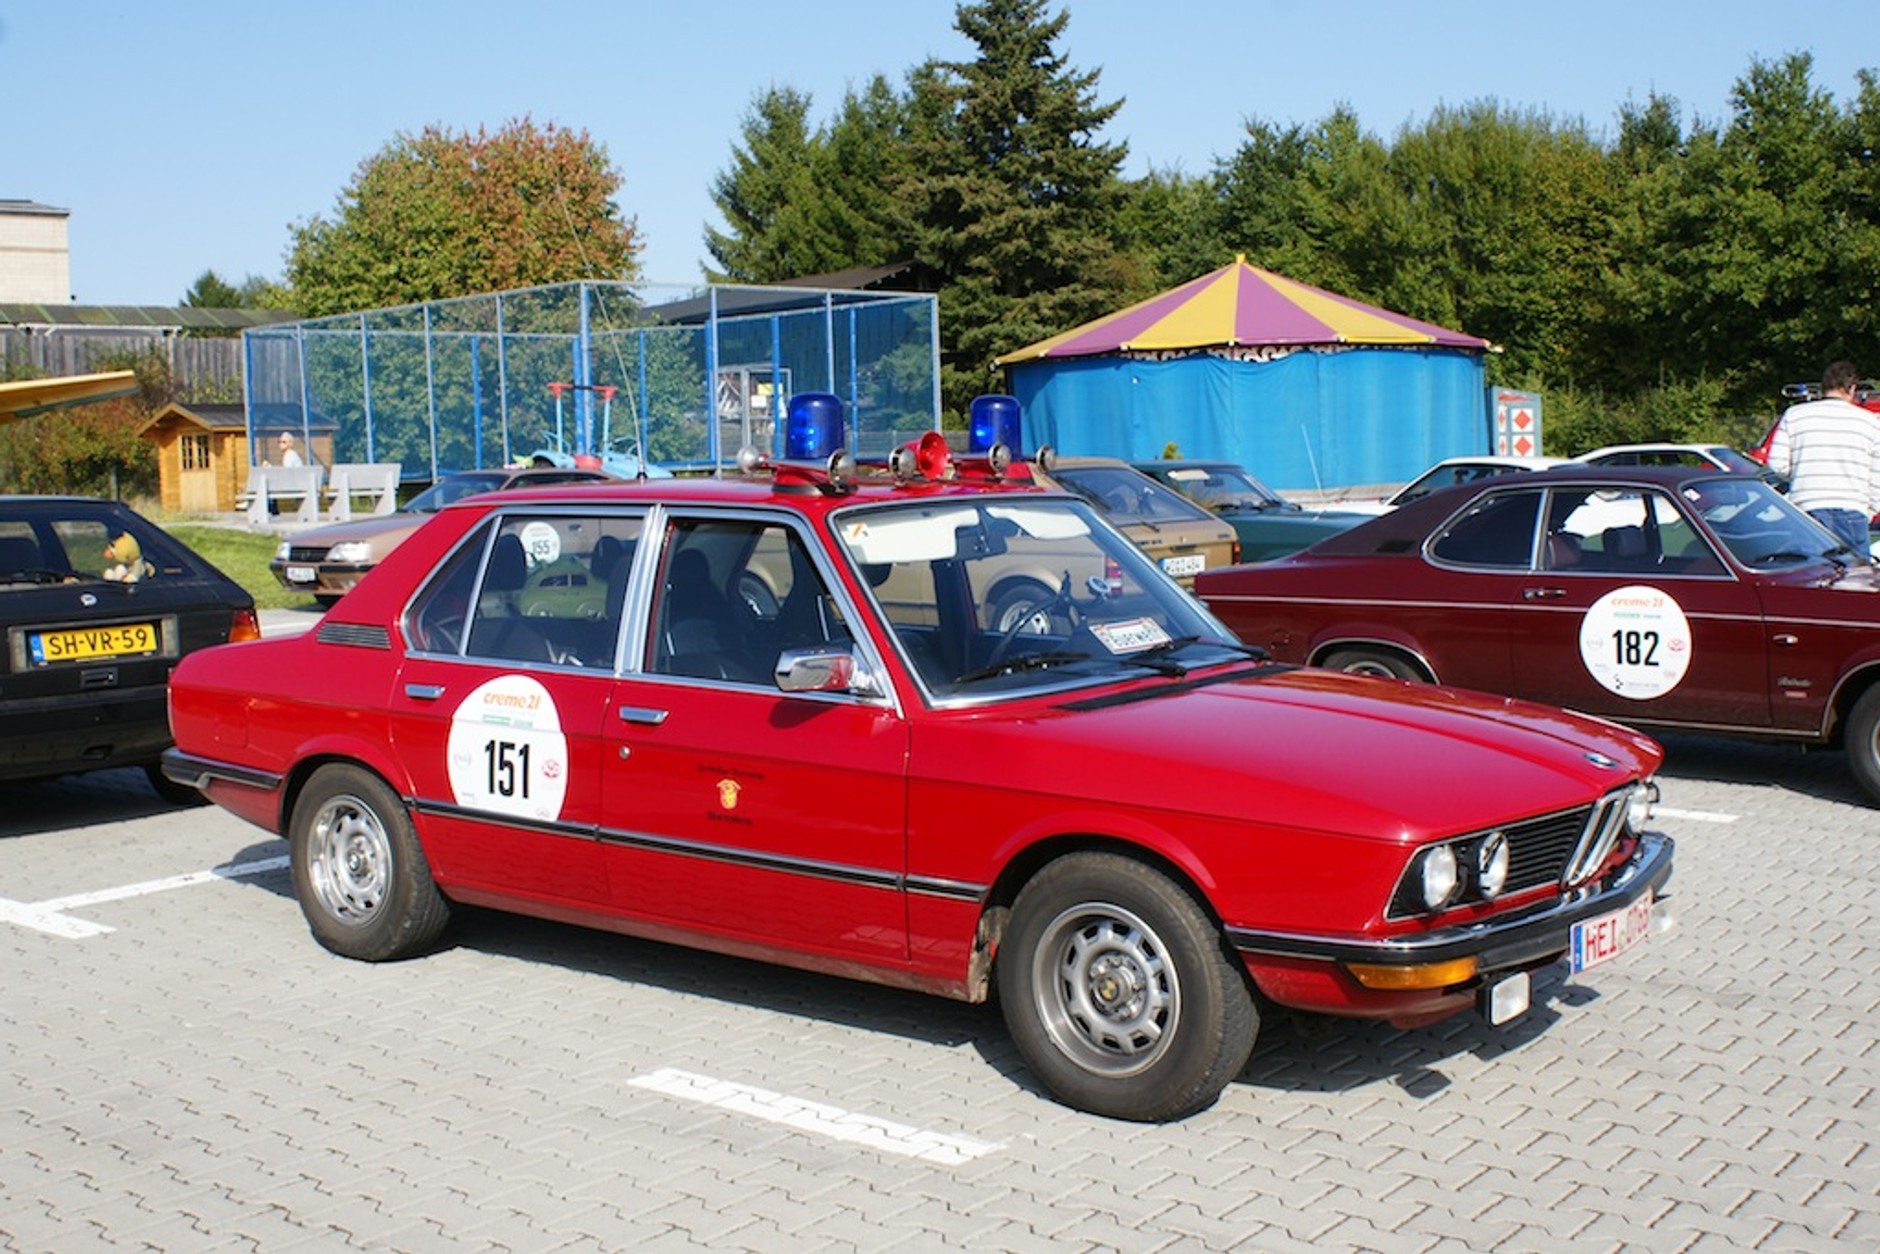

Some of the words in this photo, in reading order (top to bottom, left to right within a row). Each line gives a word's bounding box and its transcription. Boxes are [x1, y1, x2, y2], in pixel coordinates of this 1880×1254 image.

[532, 540, 550, 555] 155
[49, 628, 148, 656] SH-VR-59
[1612, 629, 1660, 667] 182
[483, 692, 526, 708] creme
[526, 694, 541, 711] 21
[484, 739, 530, 799] 151
[1585, 918, 1617, 962] HEI
